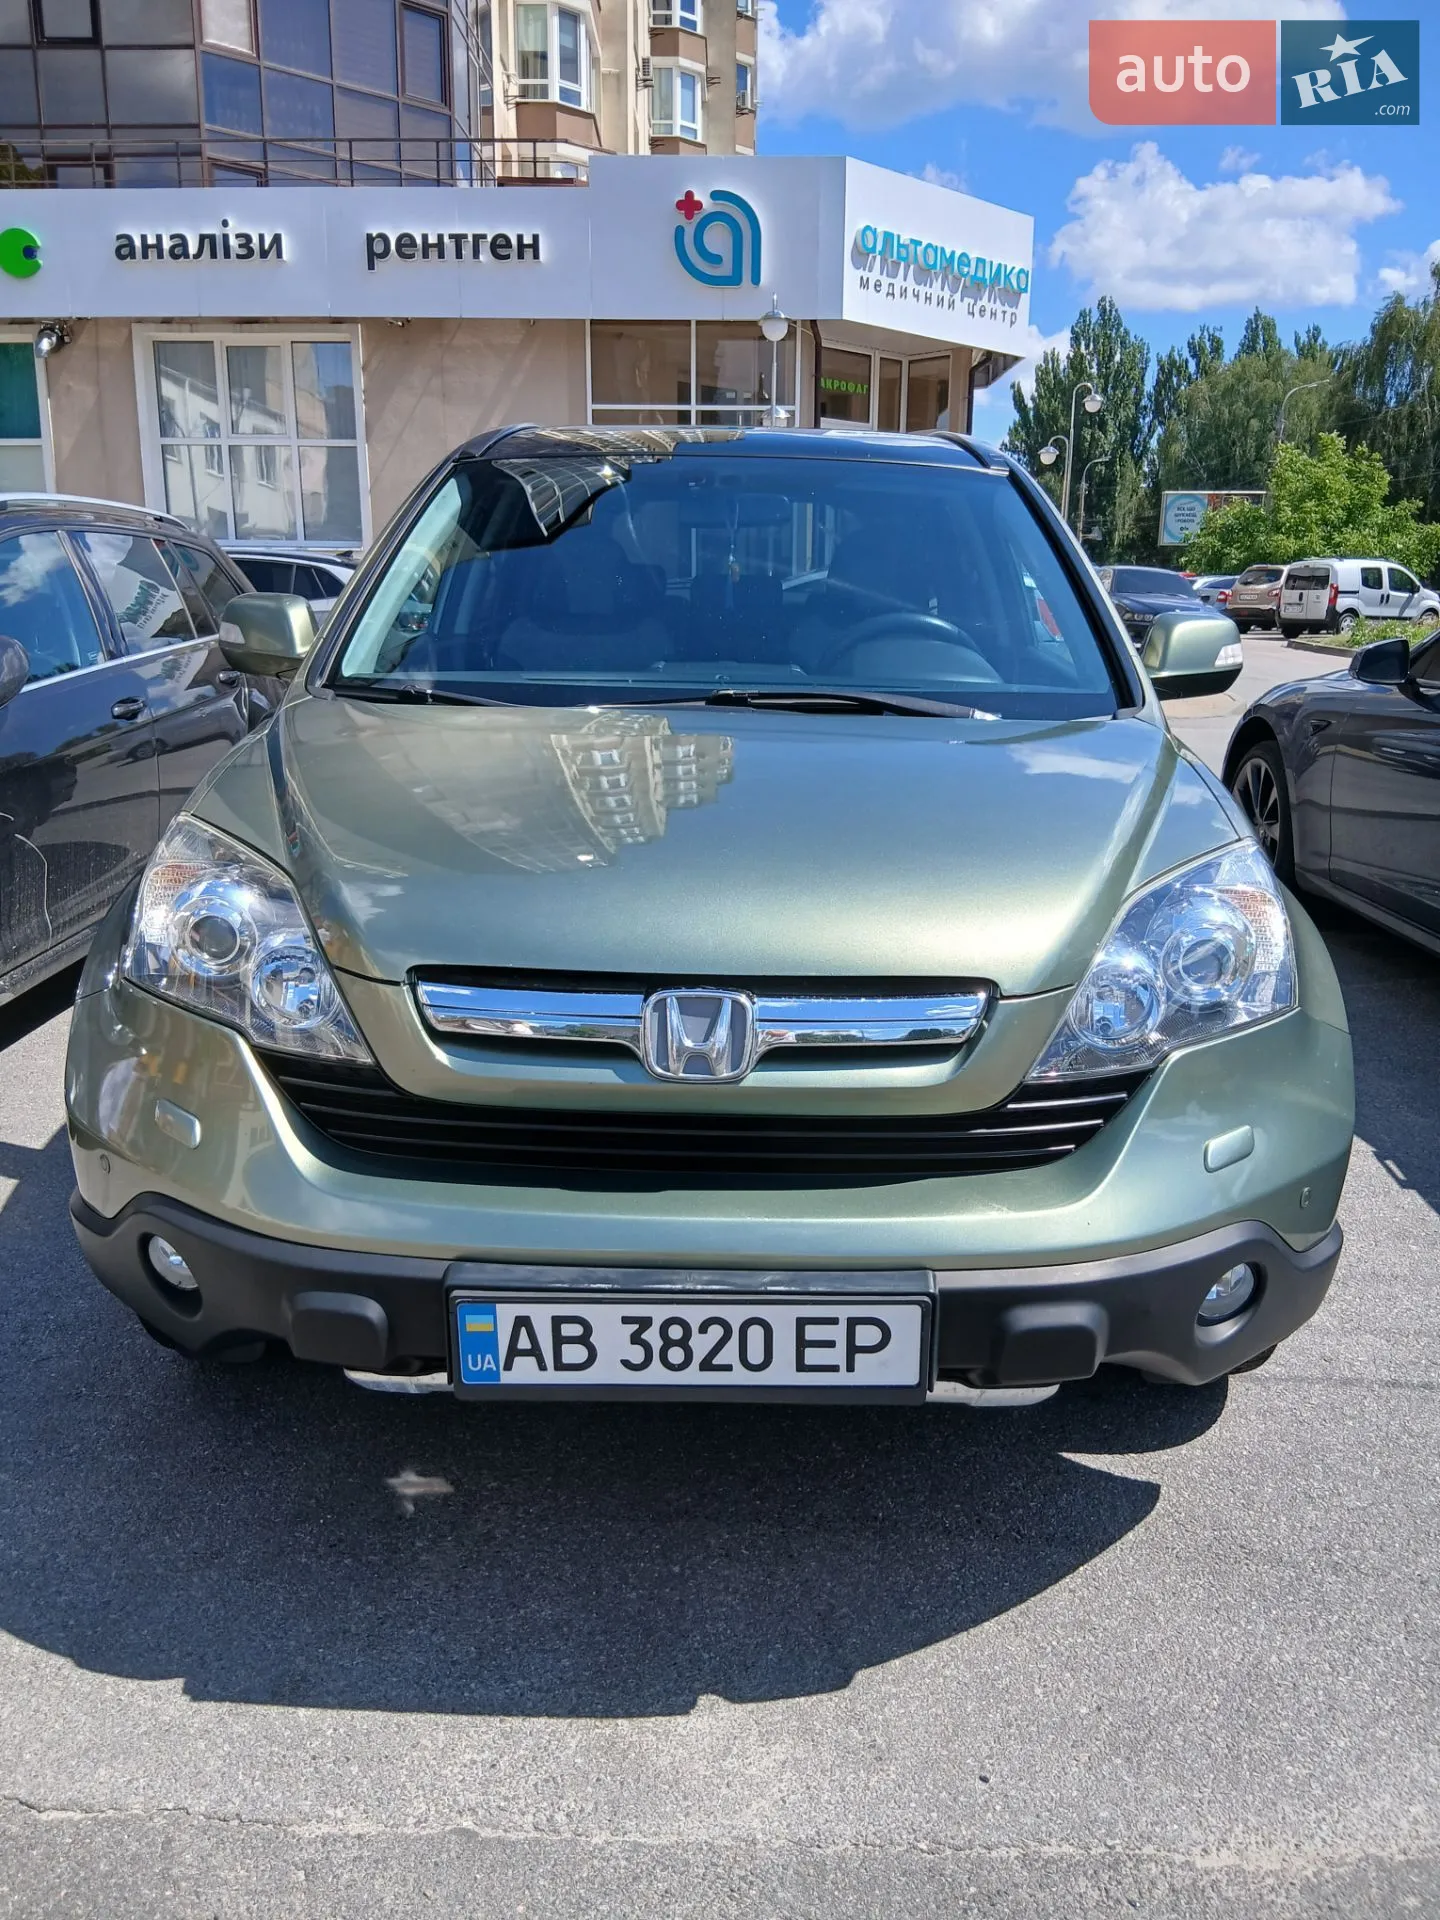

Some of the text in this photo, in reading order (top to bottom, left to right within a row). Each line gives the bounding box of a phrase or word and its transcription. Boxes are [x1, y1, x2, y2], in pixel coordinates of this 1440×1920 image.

[114, 218, 285, 261] аналізи
[366, 231, 541, 270] рентген
[859, 224, 1030, 294] альтамедика
[859, 275, 1018, 328] медичний центр
[467, 1353, 497, 1372] UA
[502, 1315, 892, 1373] AB 3820 EP
